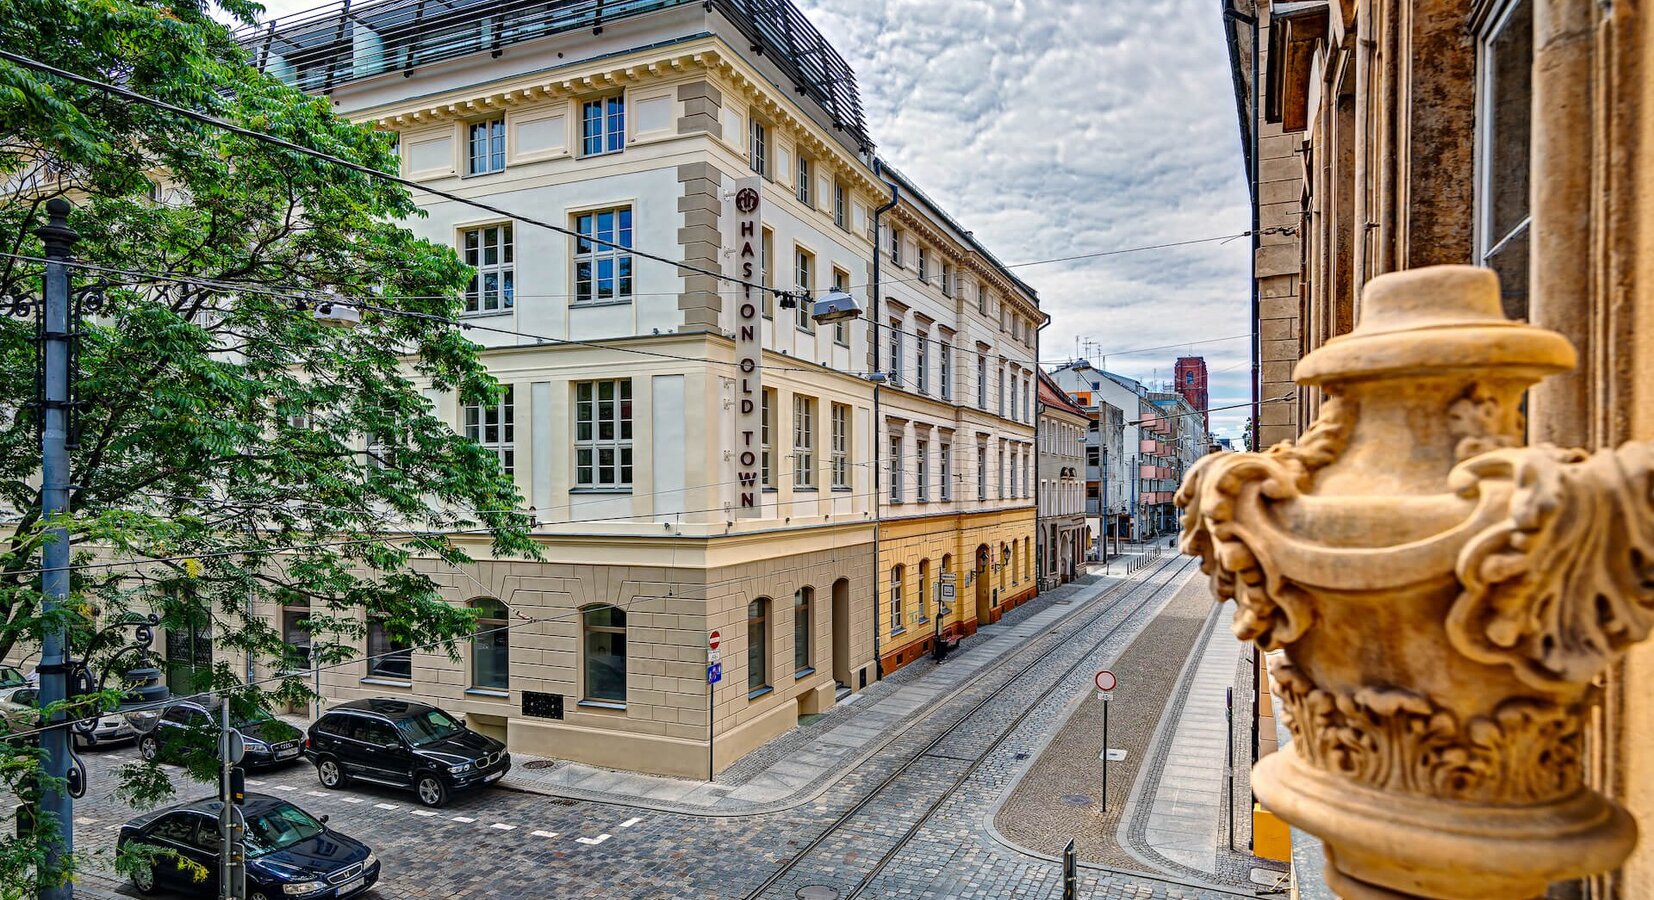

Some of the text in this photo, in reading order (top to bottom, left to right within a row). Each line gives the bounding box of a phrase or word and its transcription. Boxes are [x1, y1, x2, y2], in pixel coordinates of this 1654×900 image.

[740, 220, 755, 342] HASTON
[740, 358, 755, 415] OLD
[738, 430, 757, 508] TOWN
